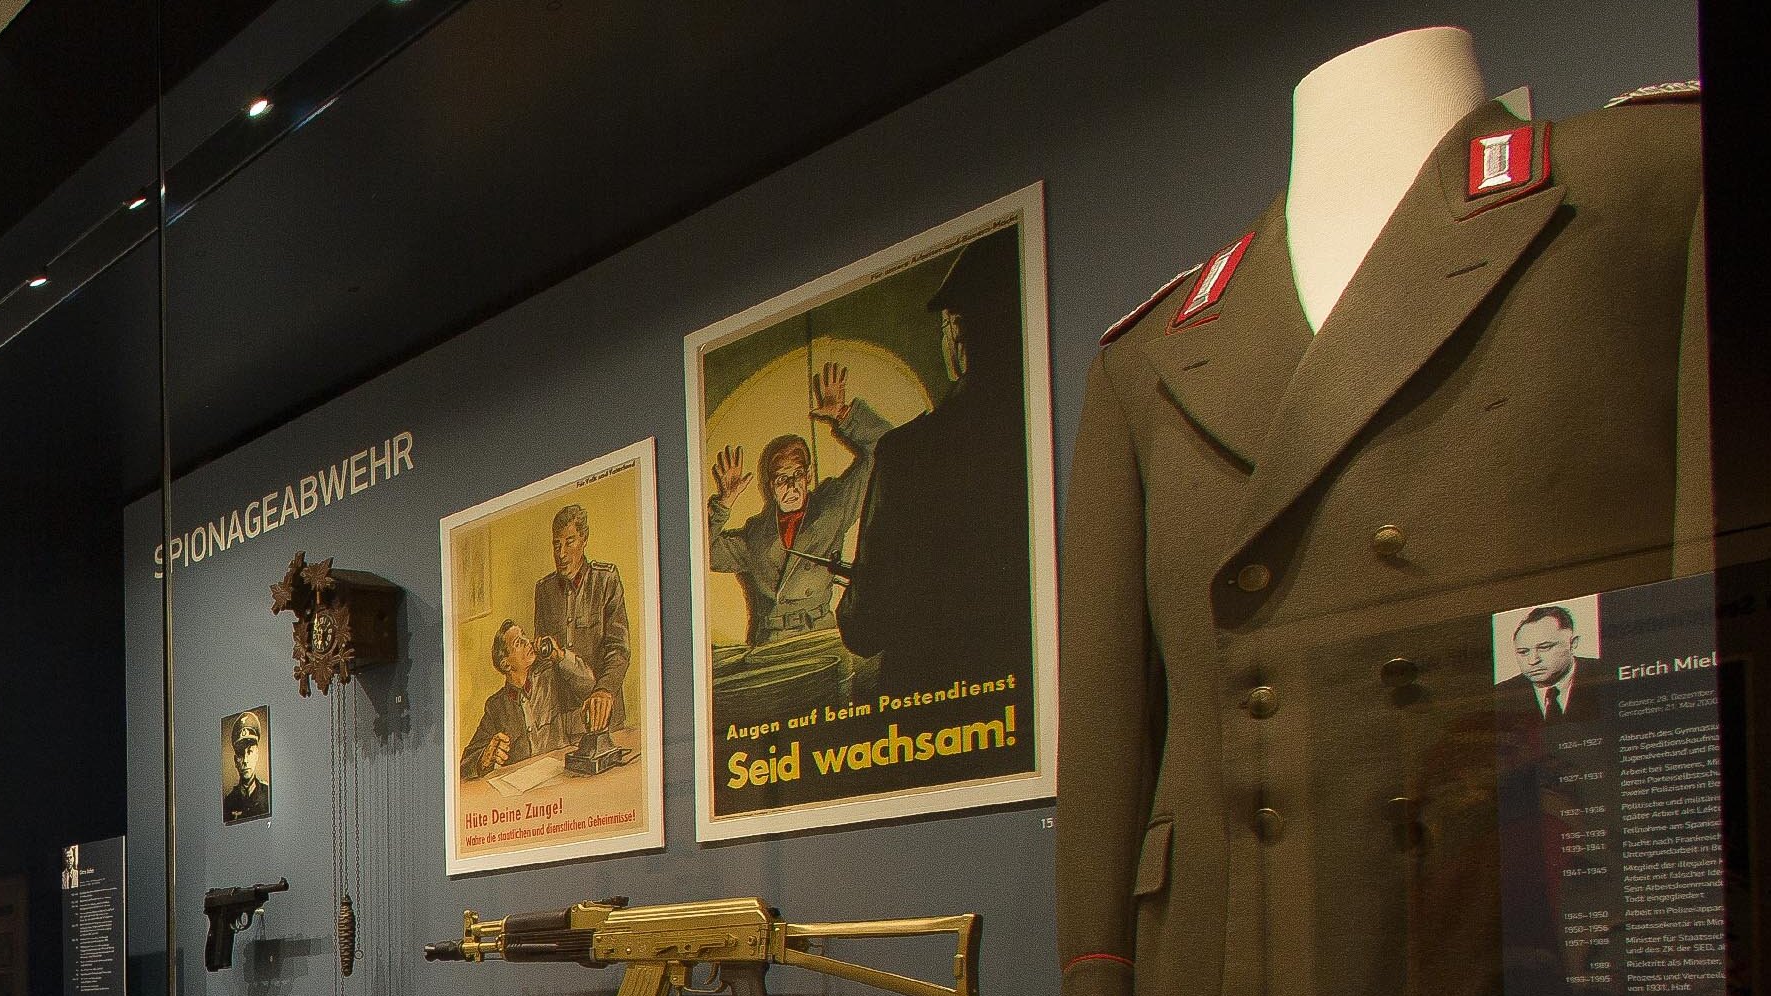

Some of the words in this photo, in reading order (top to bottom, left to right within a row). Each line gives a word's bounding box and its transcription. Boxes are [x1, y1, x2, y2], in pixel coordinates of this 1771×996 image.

[154, 431, 414, 579] SPIONAGEABWEHR
[1619, 660, 1668, 680] Erich
[726, 721, 779, 741] Augen
[788, 709, 818, 730] auf
[825, 702, 871, 722] beim
[879, 674, 1016, 712] Postendienst
[727, 741, 800, 789] Seid
[812, 704, 1016, 775] wachsam!
[465, 812, 488, 829] Hüte
[492, 806, 521, 825] Deine
[525, 797, 563, 820] Zunge!
[487, 832, 496, 843] die
[532, 824, 545, 836] und
[546, 819, 586, 834] dienstlichen
[588, 808, 636, 828] Geheimnisse!
[1040, 817, 1054, 829] 15
